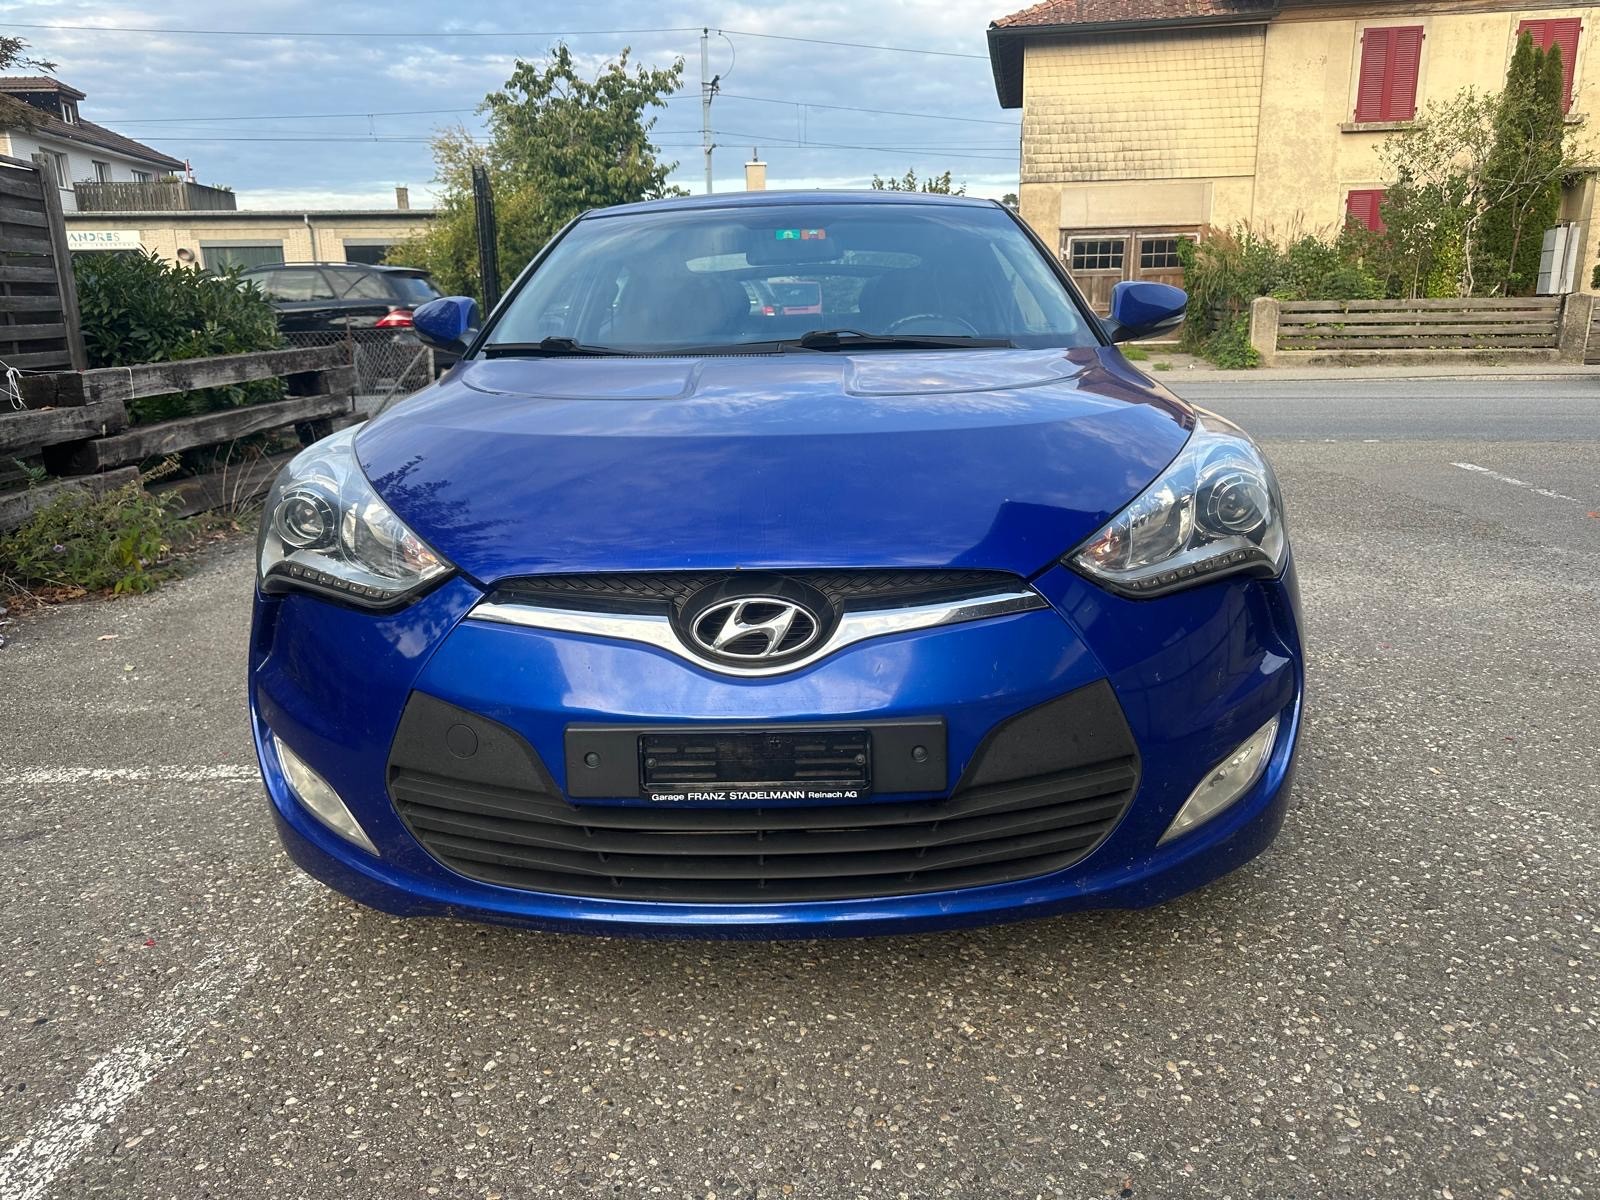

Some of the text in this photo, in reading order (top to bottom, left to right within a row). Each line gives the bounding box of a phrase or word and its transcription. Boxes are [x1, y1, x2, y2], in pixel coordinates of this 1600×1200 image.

[69, 232, 120, 242] ANDRES
[651, 790, 858, 802] Garage FRANZ STADELMANN Reinach AG
